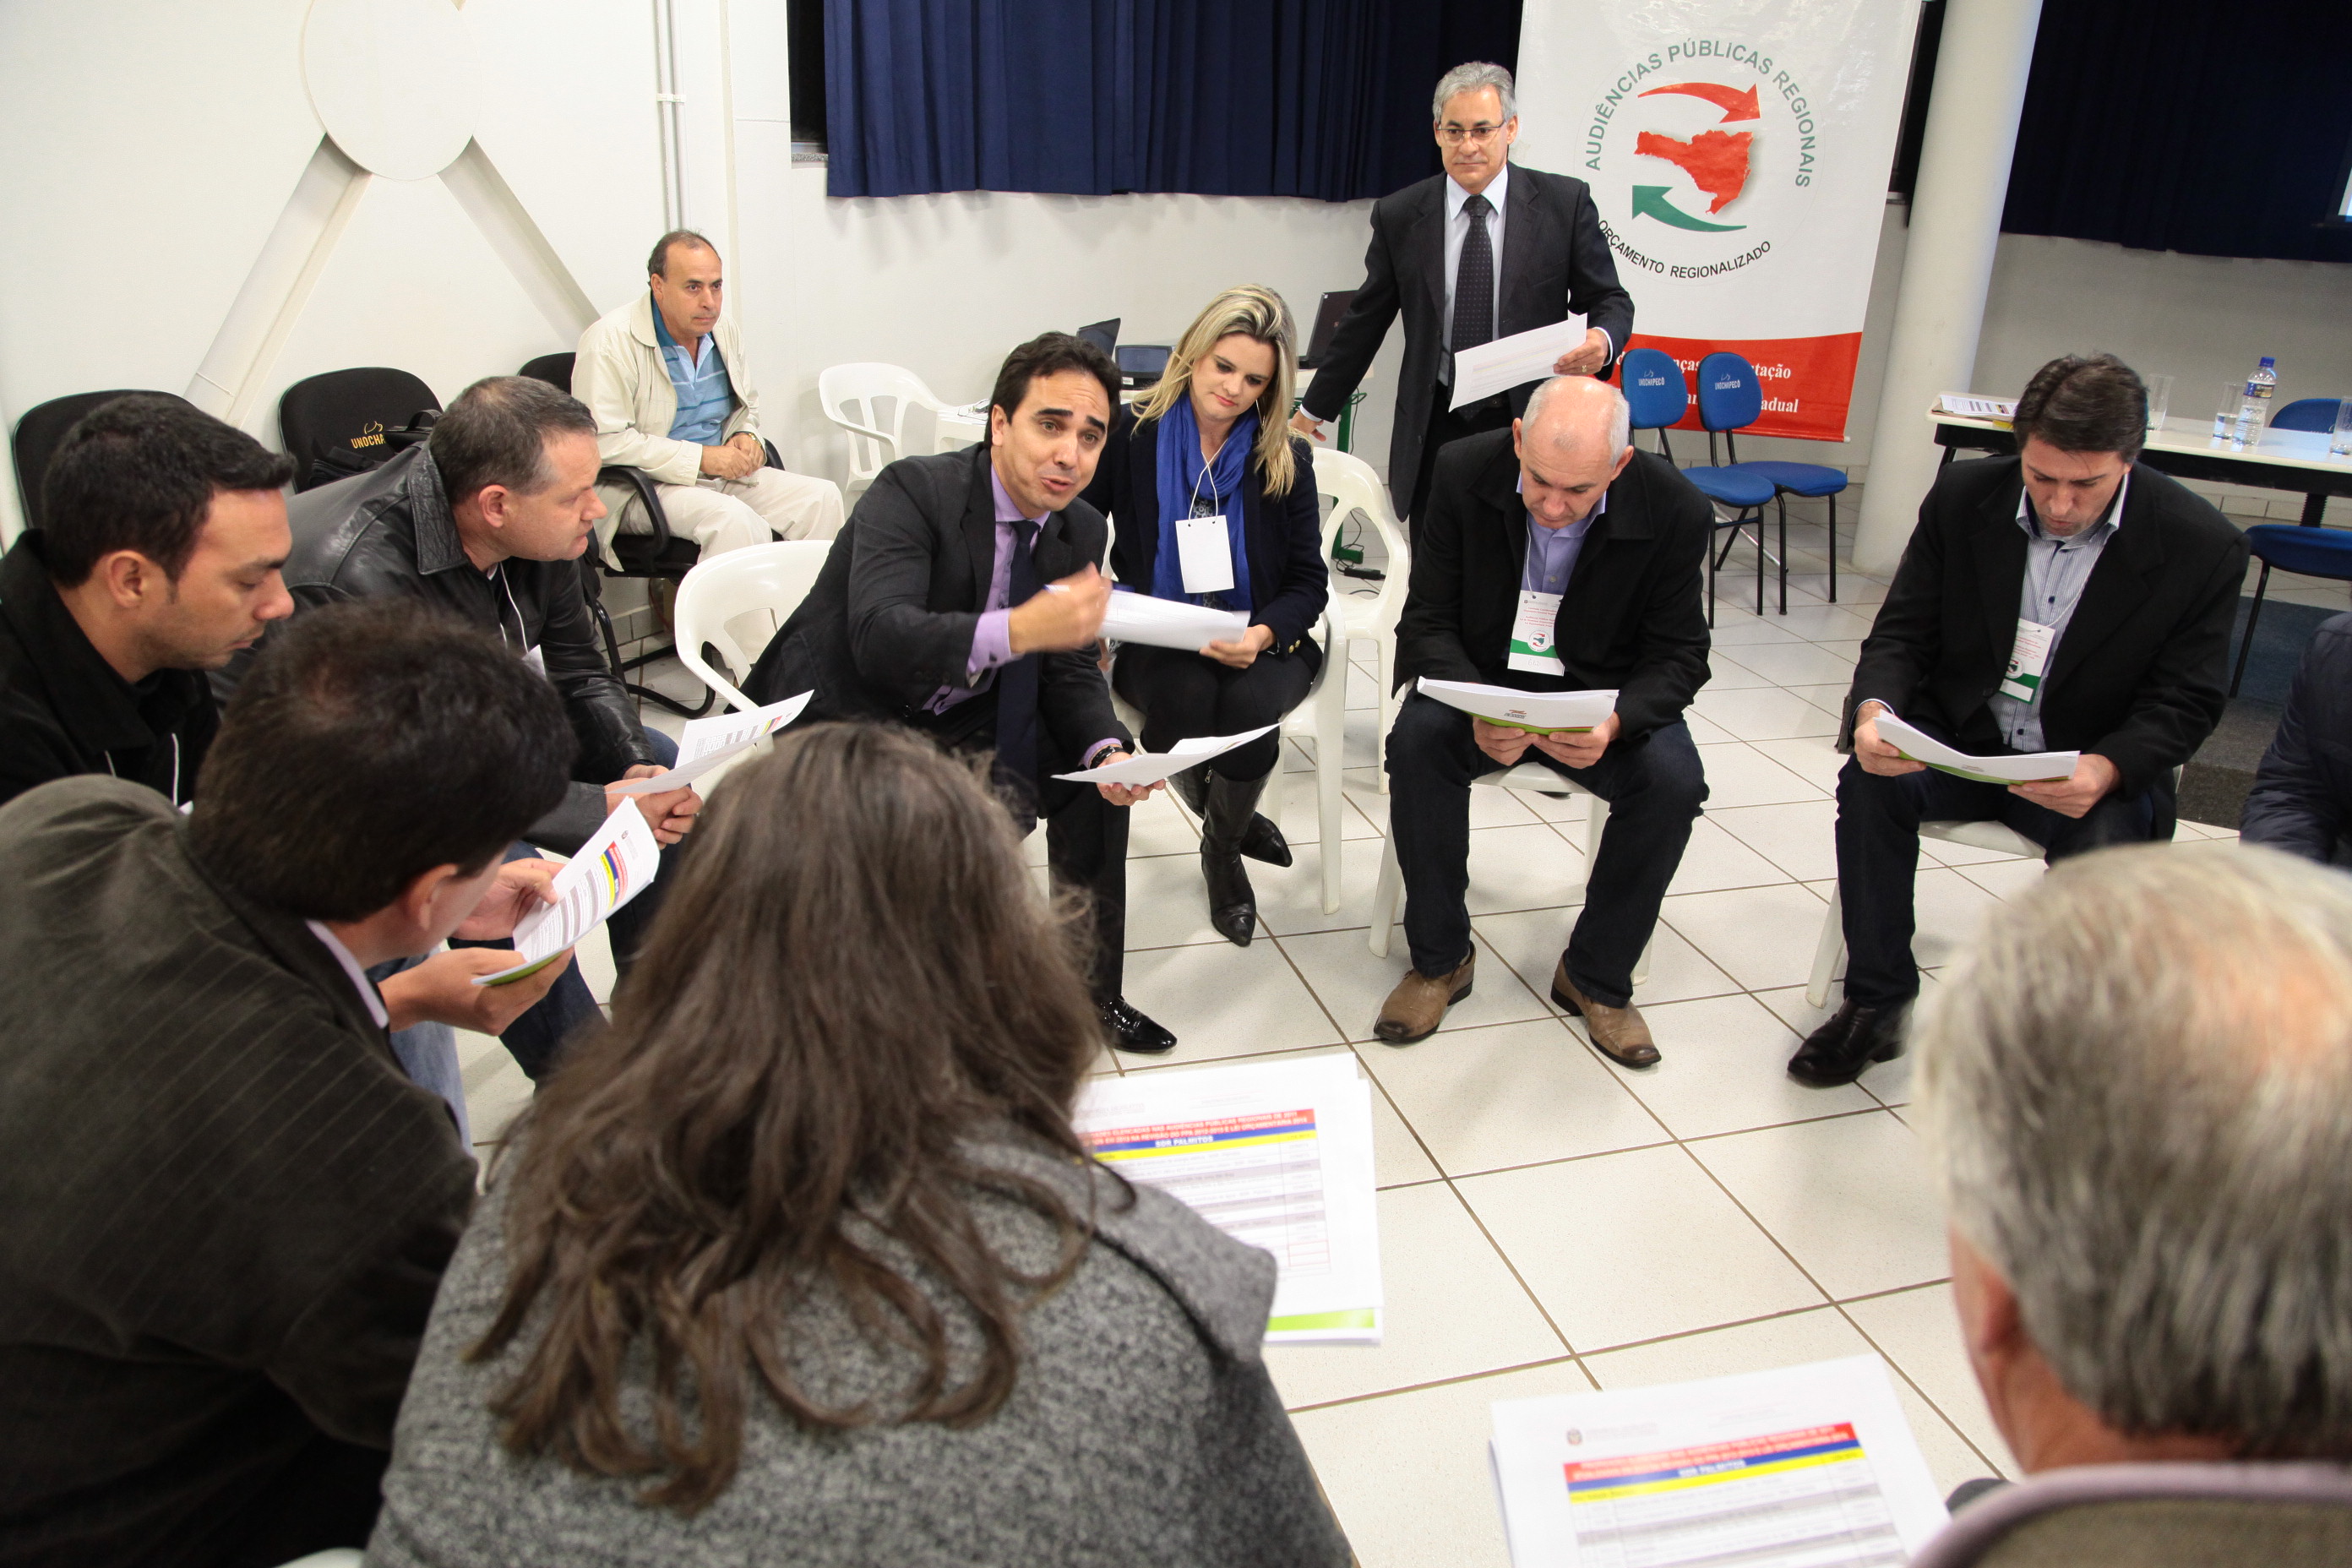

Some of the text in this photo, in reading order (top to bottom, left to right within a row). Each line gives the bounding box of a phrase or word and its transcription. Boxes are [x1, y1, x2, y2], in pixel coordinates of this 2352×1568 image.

[1585, 37, 1816, 188] AUDIÊNCIAS PÚBLICAS REGIONAIS
[1598, 220, 1771, 279] ORÇAMENTO REGIONALIZADO
[1751, 362, 1791, 381] tação
[1761, 396, 1799, 413] adual
[351, 433, 386, 449] UNOCHA
